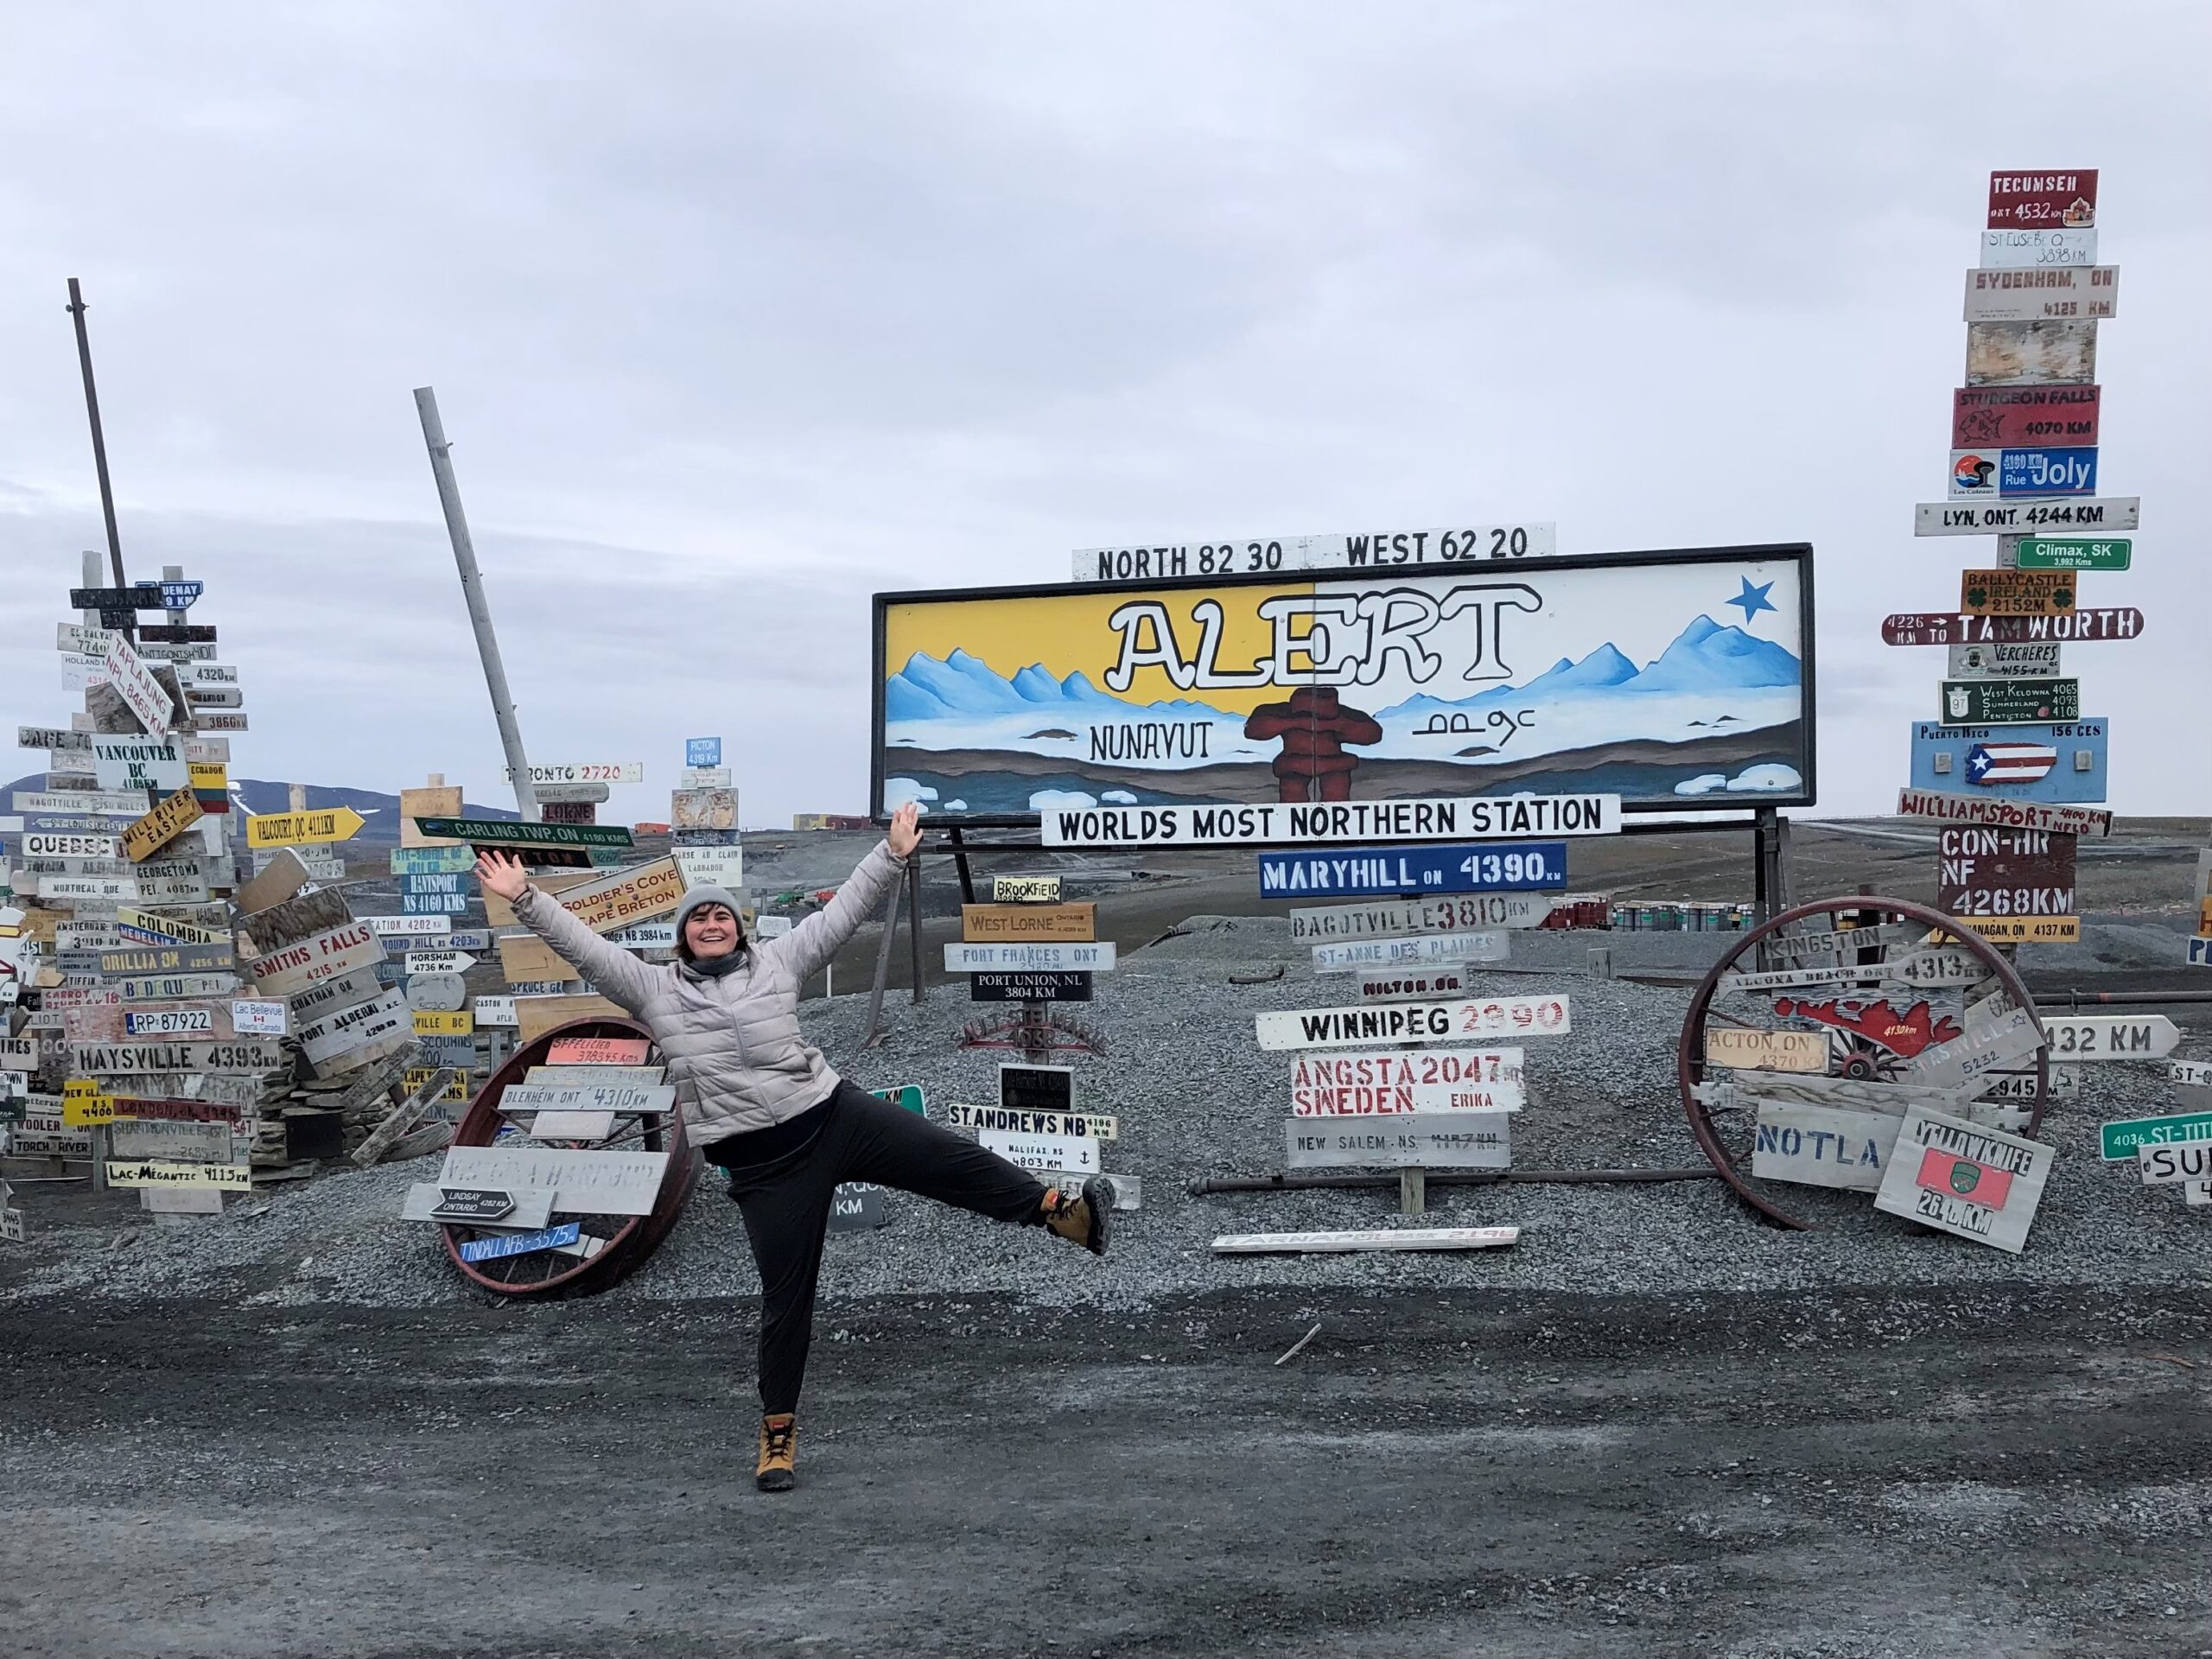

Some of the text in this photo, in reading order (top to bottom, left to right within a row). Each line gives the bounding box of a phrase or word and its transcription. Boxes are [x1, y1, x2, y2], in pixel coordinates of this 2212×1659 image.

[1993, 175, 2077, 194] TECUMSEH
[1976, 270, 2112, 289] SYDENHAM, ON
[2044, 302, 2110, 315] 4125 KM
[1961, 389, 2096, 406] STURGEON FALLS
[2067, 422, 2091, 434] KM
[2005, 456, 2091, 488] Rue Joly
[1943, 506, 2103, 527] LYN, 4244 KM
[1097, 527, 1528, 580] NORTH 82 30 WEST 62 20
[2036, 544, 2112, 558] Climax, SK
[1967, 574, 2071, 586] BALLYCASTLE
[1989, 587, 2051, 598] IRELAND
[1993, 599, 2046, 611] 2152M
[1958, 610, 2135, 642] TAMWORTH
[1104, 583, 1542, 691] ALERT
[1897, 629, 1948, 644] KM TO
[1980, 685, 2050, 697] WEST KELOWNA
[1952, 699, 1966, 709] 97
[1982, 696, 2076, 708] SUMMERLAND 4093
[1983, 709, 2031, 721] PENTICTON
[1921, 726, 2072, 740] PUERTO RICO 156
[690, 740, 715, 751] PICTON
[1090, 721, 1213, 761] NUNAVUT
[95, 745, 177, 760] VANCOUVER
[689, 754, 718, 763] 4319 Km
[129, 763, 146, 778] BC
[191, 766, 224, 774] ECUADOR
[1901, 793, 2052, 826] WILLIAMSPORT
[123, 790, 191, 845] MILL RIVER
[1058, 798, 1602, 841] WORLDS MOST NORTHERN STATION
[296, 817, 305, 842] QC
[455, 823, 518, 837] CARLING
[520, 826, 556, 841] TWP,
[558, 828, 579, 841] ON
[607, 835, 628, 843] KMS
[137, 864, 199, 878] GEORGETOWN
[1263, 858, 1442, 890] MARYHILL ON
[1942, 860, 1975, 886] NF
[54, 884, 96, 893] MONTREAL
[410, 874, 457, 893] HANTSPORT
[562, 869, 678, 912] SOLDIER'S COVE
[404, 894, 465, 912] NS KMS
[620, 890, 676, 915] BRETON
[970, 916, 1007, 931] WEST
[1010, 916, 1053, 931] LORNE
[1293, 898, 1506, 938] BAGOTVILLE 3810
[137, 914, 211, 944] COLOMBIA
[626, 930, 671, 941] NB 3984 km
[2013, 925, 2075, 936] ON 4137 KM
[415, 936, 434, 948] HILL
[1771, 928, 1881, 957] KINGSTON
[253, 925, 371, 979] SMITHS FALLS
[410, 953, 456, 962] HORSHAM
[963, 949, 1098, 963] FORT FRANCES ONT
[102, 954, 157, 970] ORILLIA
[438, 963, 453, 971] Km
[307, 965, 332, 981] 4215
[126, 978, 193, 997] BEDEQUE
[512, 982, 545, 992] SPRUCE
[979, 975, 1083, 988] PORT UNION, NL
[290, 988, 335, 1012] CHATHAM
[1005, 987, 1055, 998] 3804 KM
[235, 1004, 248, 1014] Lac
[162, 1013, 207, 1030] 87922
[453, 1019, 463, 1027] BC
[1300, 1007, 1449, 1041] WINNIPEG
[299, 1025, 326, 1044] PORT
[2111, 1025, 2152, 1052] KM
[1708, 1034, 1809, 1051] ACTON, ON
[80, 1047, 194, 1071] HAYSVILLE
[1759, 1054, 1797, 1068] 4370
[1962, 1051, 2000, 1074] 5232
[404, 1071, 425, 1082] CAPE
[1422, 1055, 1501, 1084] 2047
[65, 1089, 81, 1097] NEW
[560, 1091, 581, 1103] ONT
[1295, 1086, 1493, 1116] SWEDEN ERIKA
[82, 1108, 111, 1116] 4400
[975, 1108, 1086, 1136] ANDREWS NB
[16, 1141, 87, 1152] TORCH RIVER
[1298, 1136, 1385, 1150] NEW SALEM
[2113, 1134, 2145, 1146] 4036
[1915, 1120, 2033, 1177] YELLOWKNIFE
[1047, 1160, 1062, 1169] KM
[836, 1201, 863, 1217] KM
